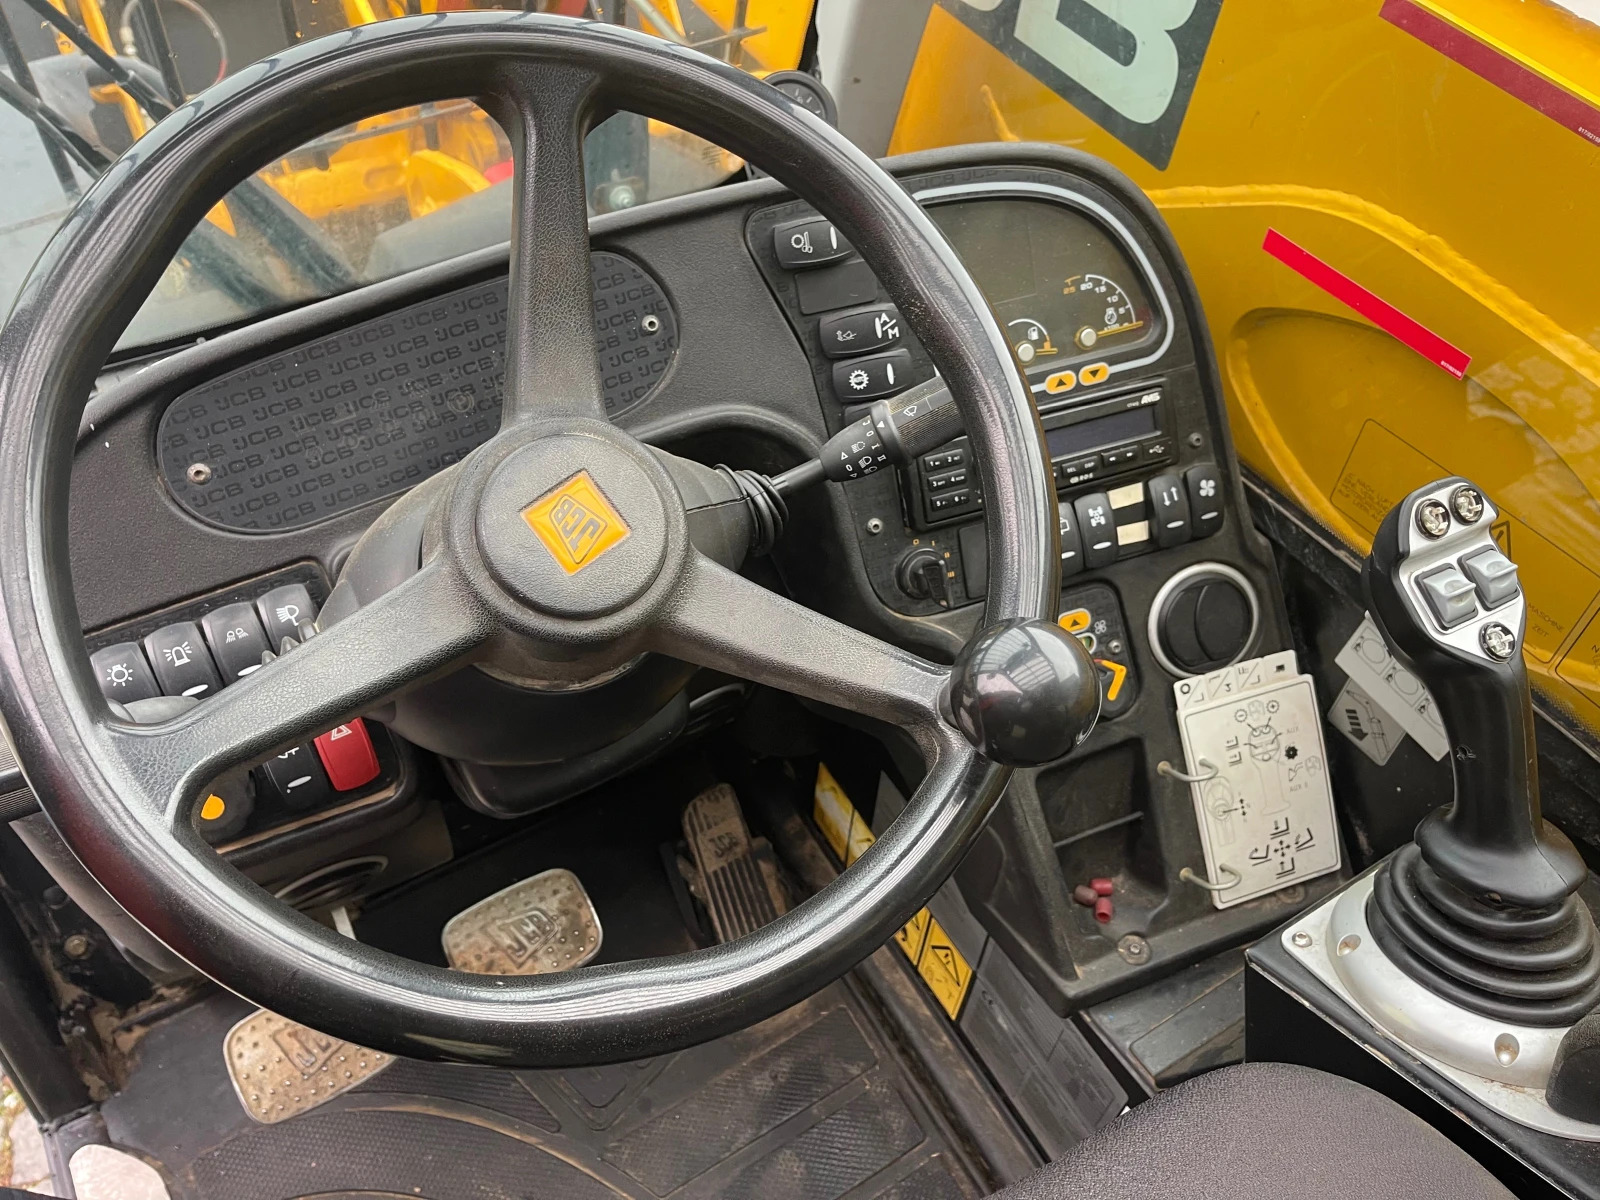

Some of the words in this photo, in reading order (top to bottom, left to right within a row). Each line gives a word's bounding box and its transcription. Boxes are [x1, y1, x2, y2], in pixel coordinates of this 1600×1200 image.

[1080, 282, 1092, 290] 20
[1106, 295, 1118, 303] 10
[349, 324, 395, 347] JCB
[402, 308, 448, 330] JCB
[454, 292, 498, 314] JCB
[597, 309, 637, 331] JCB
[214, 387, 266, 410] JCB
[273, 369, 322, 392] JCB
[329, 352, 377, 376] JCB
[383, 335, 429, 358] JCB
[435, 320, 480, 342] JCB
[609, 346, 650, 368] JCB
[194, 415, 246, 439] JCB
[253, 397, 303, 421] JCB
[309, 380, 358, 404] JCB
[364, 363, 410, 385] JCB
[416, 346, 462, 369] JCB
[191, 482, 244, 507] JCB
[250, 463, 299, 489] JCB
[360, 427, 406, 451] JCB
[412, 410, 457, 433] JCB
[232, 425, 283, 450] JCB
[270, 435, 319, 460] JCB
[325, 417, 373, 441] JCB
[230, 492, 281, 517] JCB
[288, 473, 335, 497] JCB
[342, 455, 388, 479] JCB
[394, 436, 439, 460] JCB
[445, 419, 490, 442] JCB
[267, 501, 316, 526] JCB
[324, 483, 370, 507] JCB
[375, 464, 421, 488] JCB
[553, 499, 600, 552] JCB
[1528, 603, 1566, 632] MASCHINE
[498, 914, 554, 957] JCB
